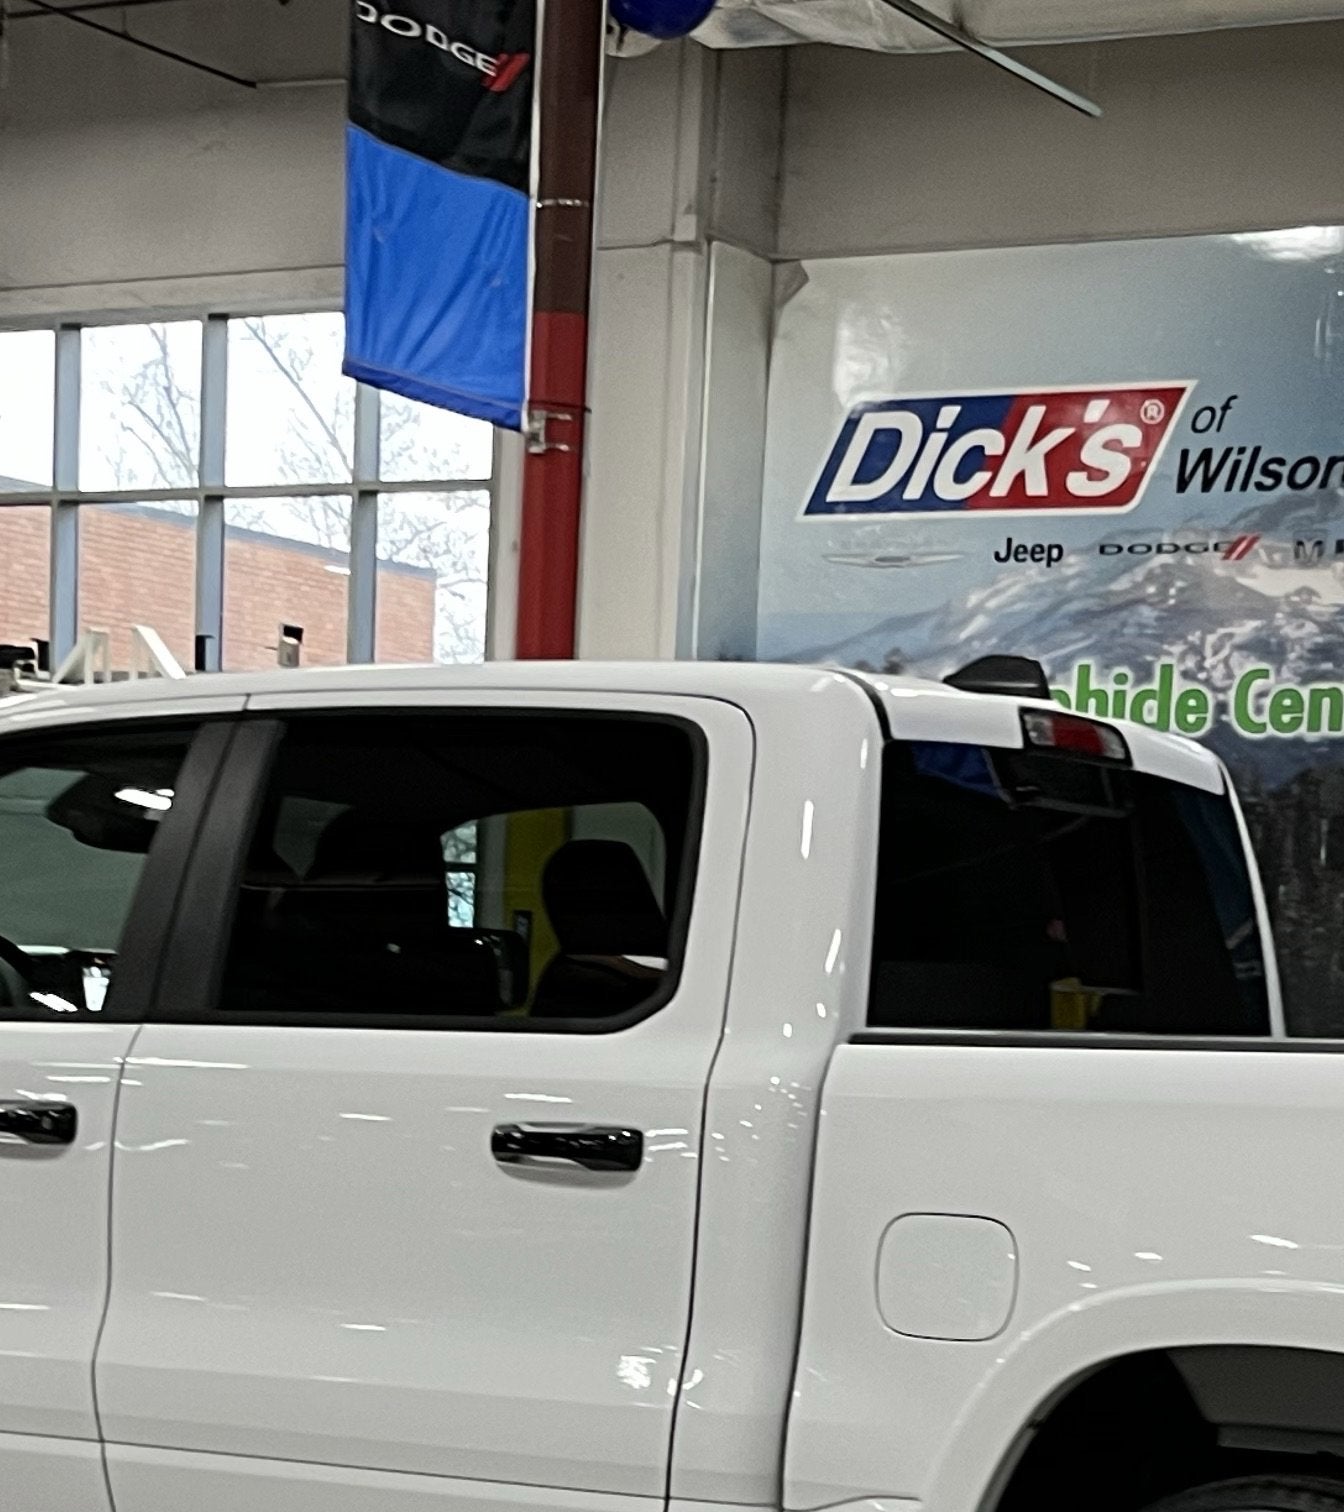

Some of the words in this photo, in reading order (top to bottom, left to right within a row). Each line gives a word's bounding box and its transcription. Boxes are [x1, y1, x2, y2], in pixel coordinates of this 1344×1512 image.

[1191, 396, 1237, 434] of
[826, 400, 1142, 502] Dick's
[994, 537, 1063, 567] Jeep
